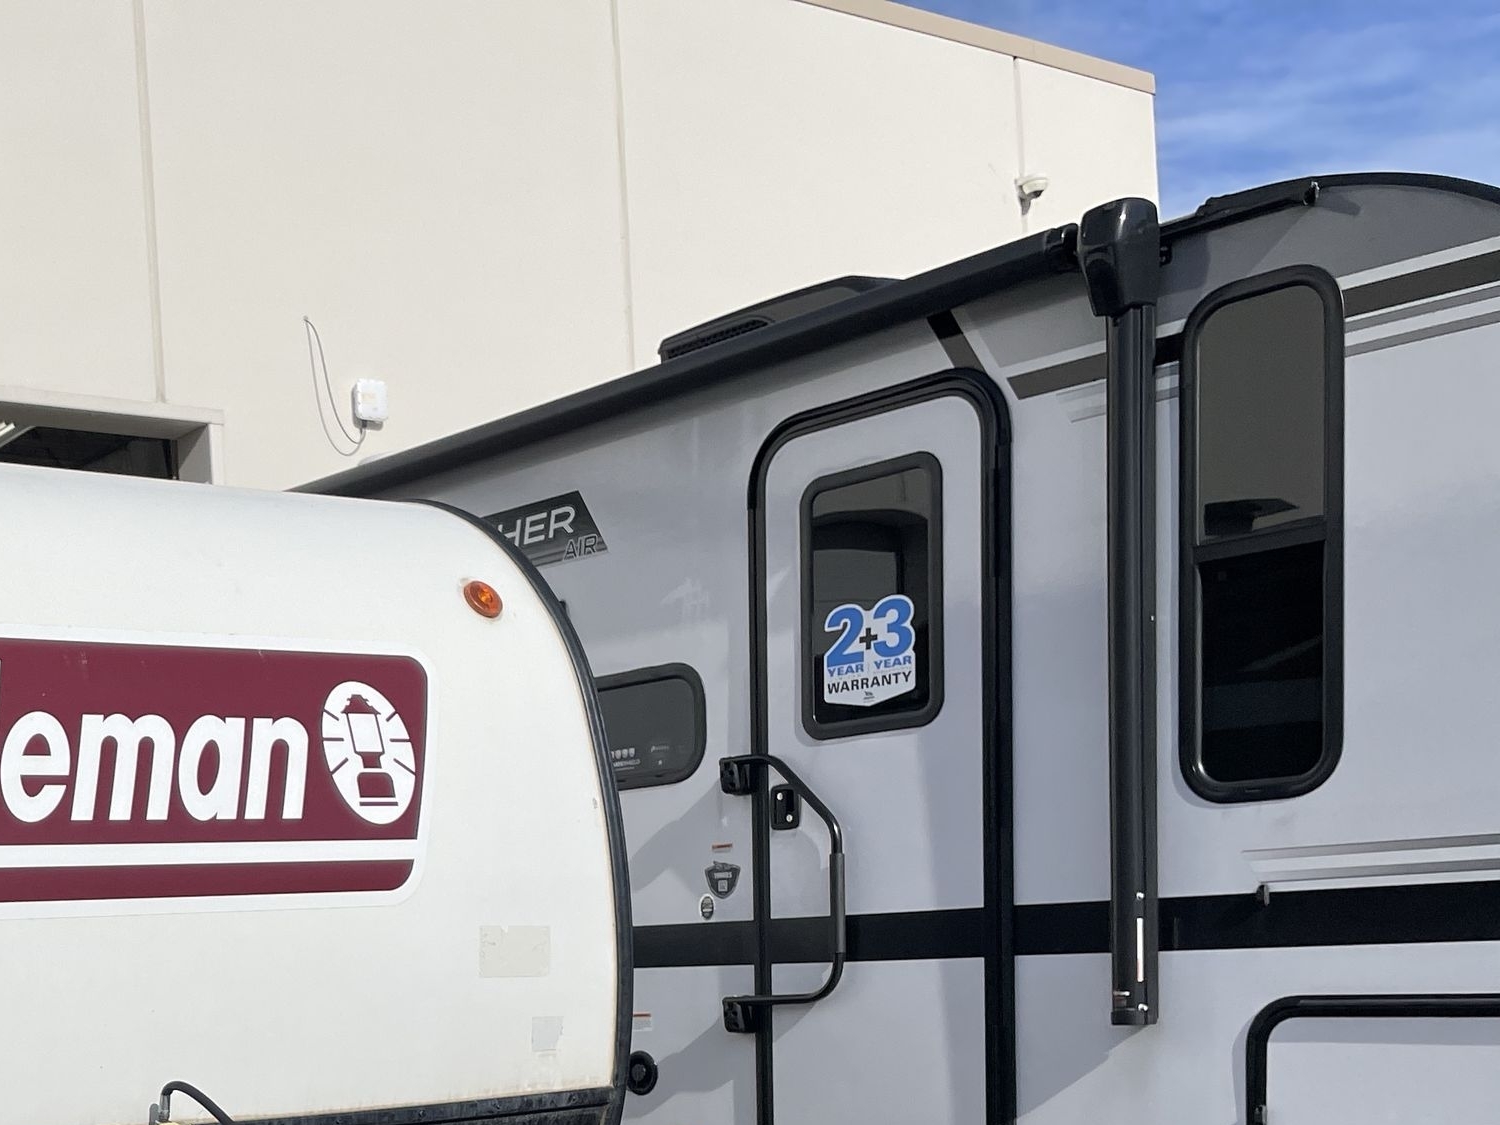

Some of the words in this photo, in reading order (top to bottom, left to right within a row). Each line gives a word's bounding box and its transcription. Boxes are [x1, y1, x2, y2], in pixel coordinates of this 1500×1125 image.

[562, 533, 599, 561] AIR
[827, 663, 865, 678] YEAR
[873, 655, 912, 670] YEAR
[827, 670, 913, 695] WARRANTY
